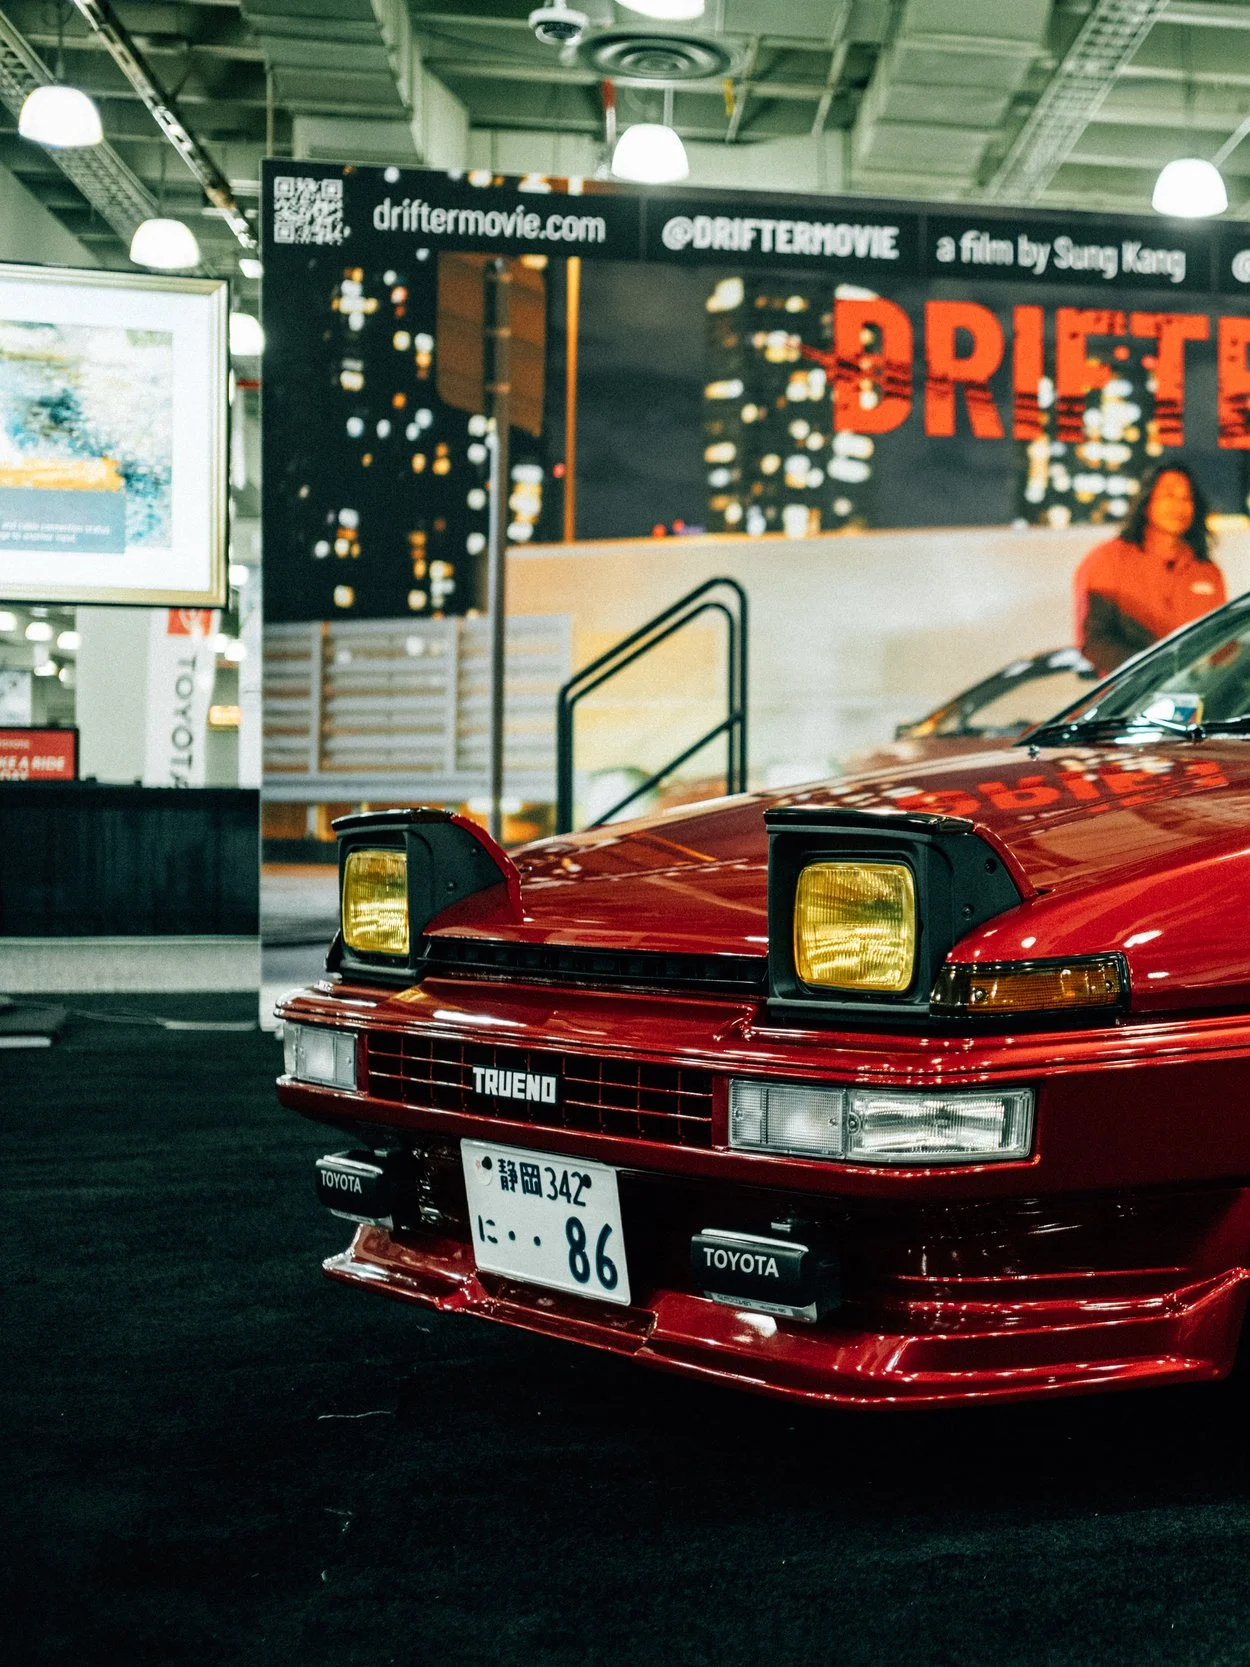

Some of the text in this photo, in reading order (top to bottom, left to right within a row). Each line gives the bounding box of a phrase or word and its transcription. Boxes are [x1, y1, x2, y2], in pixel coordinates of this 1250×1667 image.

[372, 196, 606, 243] driftermovie.com
[661, 215, 900, 260] @DRIFTERMOVIE
[936, 229, 1187, 284] a film by Sung Kang
[473, 1067, 557, 1104] TRUENO
[320, 1169, 363, 1194] TOYOTA
[703, 1247, 780, 1278] TOYOTA
